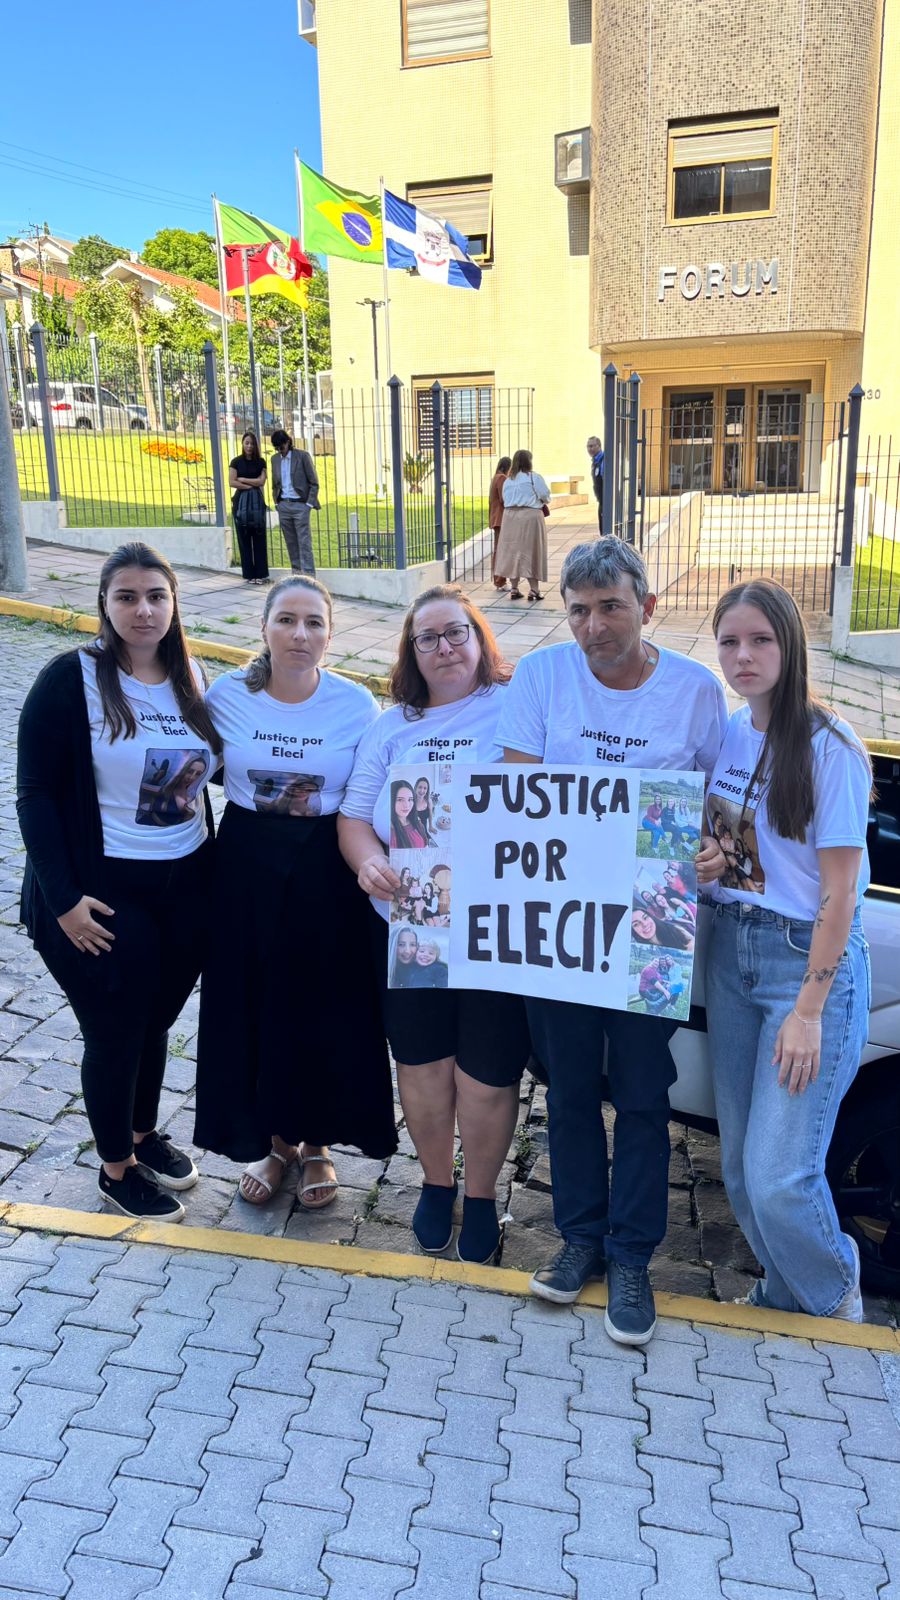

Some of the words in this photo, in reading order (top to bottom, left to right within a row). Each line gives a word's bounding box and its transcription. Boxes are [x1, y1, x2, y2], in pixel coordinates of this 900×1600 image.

[658, 258, 778, 301] FORUM
[863, 389, 881, 400] 30
[140, 711, 177, 724] Justiça
[161, 726, 188, 736] Eleci
[252, 730, 297, 745] Justiça
[302, 737, 323, 746] por
[580, 725, 621, 746] Justiça
[624, 737, 648, 748] por
[453, 739, 473, 748] por
[272, 746, 304, 759] Eleci
[428, 751, 455, 761] Eleci
[596, 747, 625, 763] Eleci
[715, 780, 742, 795] nossa
[465, 772, 630, 822] JUSTIÇA
[494, 838, 568, 882] POR
[468, 900, 629, 973] ELECI!
